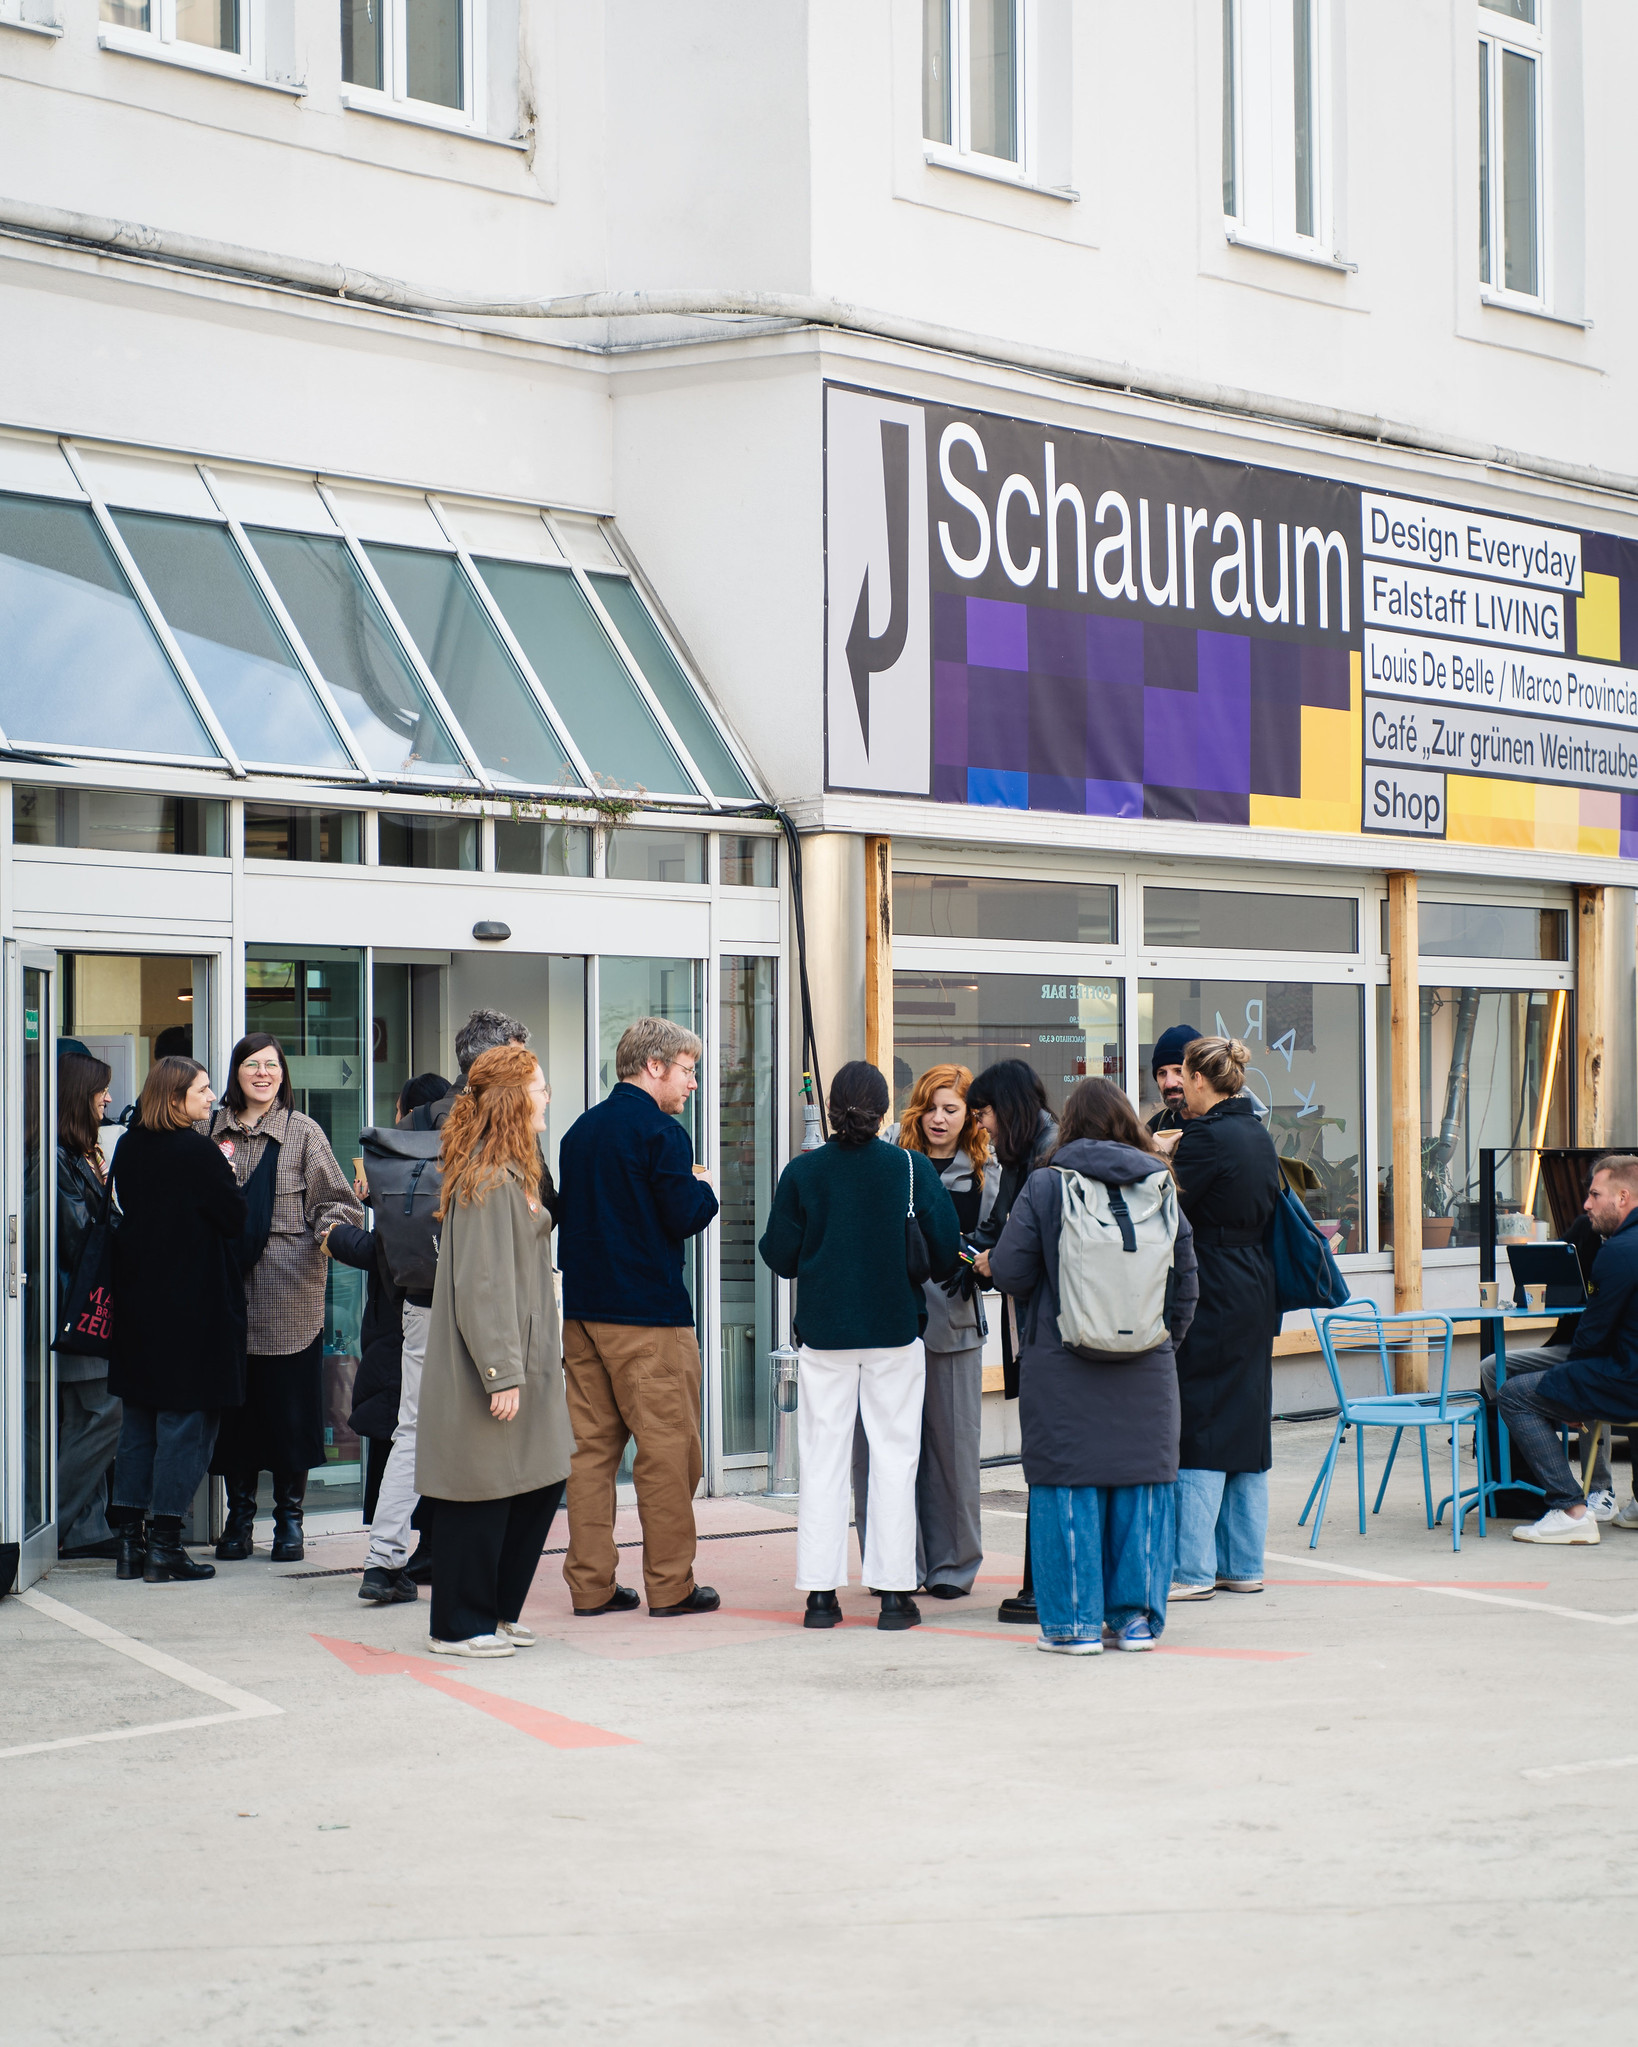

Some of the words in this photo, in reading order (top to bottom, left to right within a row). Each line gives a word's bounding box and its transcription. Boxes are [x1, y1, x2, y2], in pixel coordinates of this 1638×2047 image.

[937, 421, 1351, 633] Schauraum
[1371, 507, 1459, 563] Design
[1466, 525, 1576, 586] Everyday
[1373, 575, 1466, 625] Falstaff
[1475, 592, 1559, 640] LIVING
[1371, 643, 1417, 685] Louis
[1422, 650, 1446, 688] De
[1452, 655, 1494, 695] Belle
[1498, 660, 1507, 702] /
[1511, 663, 1562, 705] Marco
[1372, 711, 1418, 753] Café
[1470, 727, 1534, 767] grünen
[1373, 779, 1440, 829] Shop
